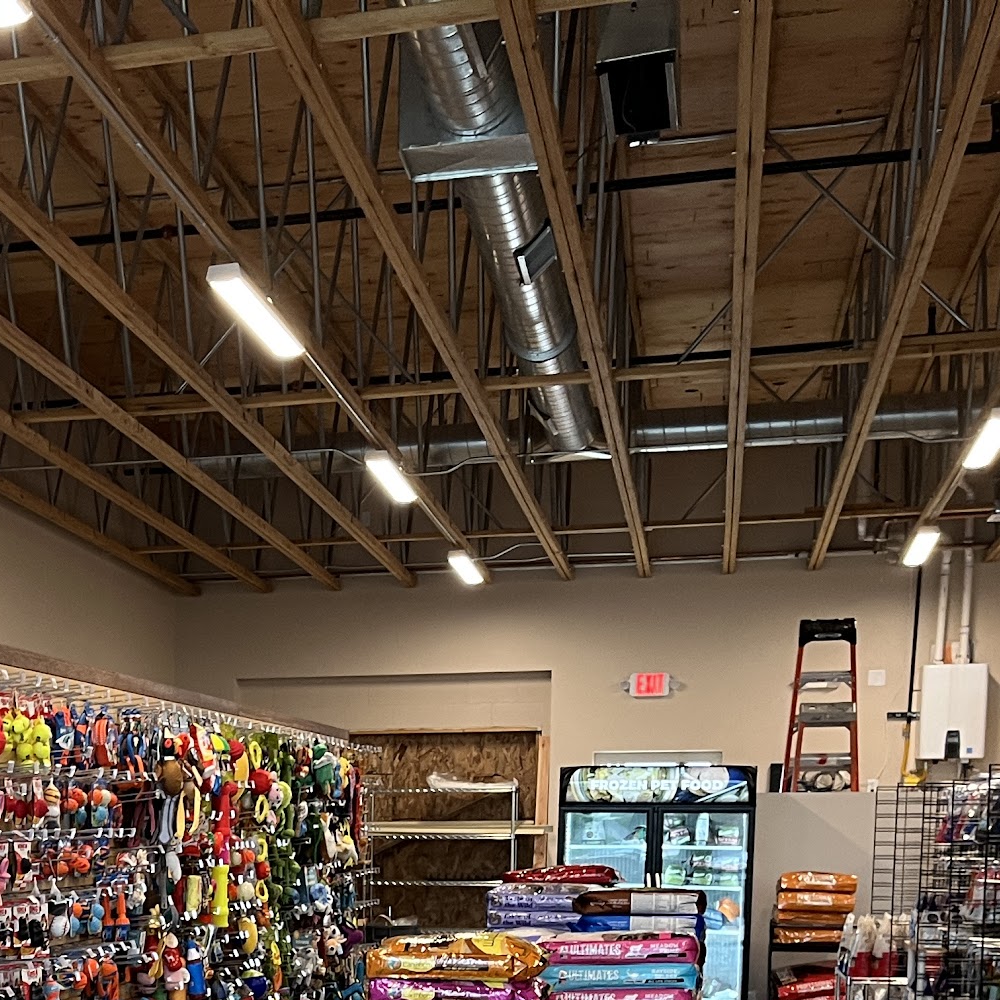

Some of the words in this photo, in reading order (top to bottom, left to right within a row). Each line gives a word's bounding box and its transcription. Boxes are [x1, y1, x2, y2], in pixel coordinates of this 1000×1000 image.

[636, 673, 664, 694] EXIT
[590, 780, 648, 791] FROZEN
[650, 780, 678, 791] PET
[681, 780, 724, 791] FOOD
[570, 944, 621, 956] ULTIMATES
[568, 969, 619, 981] ULTIMATES
